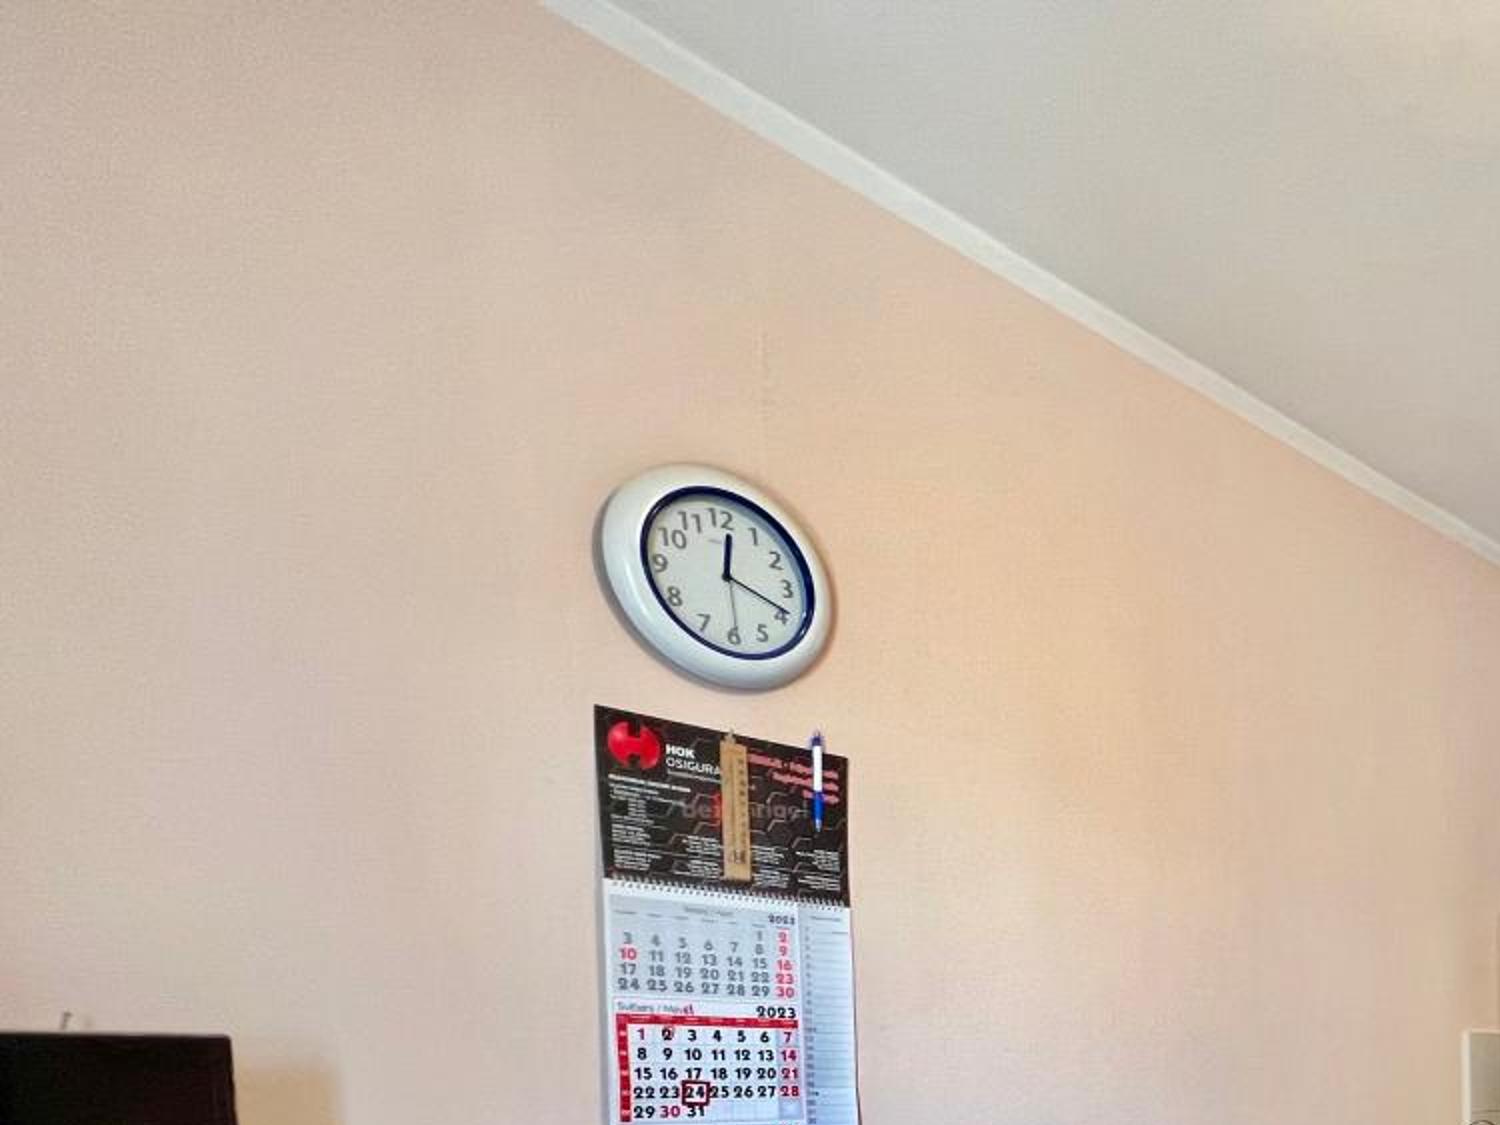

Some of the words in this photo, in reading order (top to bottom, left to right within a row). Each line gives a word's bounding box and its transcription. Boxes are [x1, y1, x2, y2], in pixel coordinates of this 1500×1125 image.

[678, 511, 703, 534] 11
[708, 507, 734, 531] 12
[658, 527, 687, 550] 10
[748, 527, 759, 546] 1
[652, 553, 668, 573] 9
[768, 551, 784, 571] 2
[666, 586, 683, 607] 8
[781, 579, 794, 599] 3
[696, 614, 712, 632] 7
[774, 611, 790, 626] 4
[727, 628, 741, 645] 6
[756, 624, 769, 643] 5
[666, 744, 695, 758] HOK
[623, 932, 632, 944] 3
[651, 934, 660, 946] 4
[678, 937, 687, 948] 5
[704, 939, 714, 950] 6
[730, 942, 738, 952] 7
[755, 944, 764, 955] 8
[779, 946, 787, 956] 9
[756, 931, 762, 941] 1
[619, 948, 637, 960] 10
[649, 950, 664, 962] 11
[675, 952, 691, 964] 12
[702, 954, 717, 966] 13
[727, 958, 743, 966] 14
[753, 958, 768, 969] 15
[777, 960, 793, 970] 16
[620, 963, 636, 975] 17
[649, 965, 665, 977] 18
[675, 967, 692, 978] 19
[700, 968, 719, 980] 20
[728, 970, 744, 981] 21
[751, 972, 769, 983] 22
[775, 974, 793, 984] 23
[617, 977, 640, 990] 24
[646, 979, 667, 992] 25
[674, 981, 694, 993] 26
[701, 983, 719, 994] 27
[726, 984, 745, 996] 28
[751, 986, 770, 997] 29
[775, 987, 794, 998] 30
[756, 1006, 796, 1019] 2023
[637, 1028, 645, 1041] 1
[661, 1028, 673, 1041] 2
[687, 1029, 697, 1041] 3
[713, 1030, 722, 1042] 4
[737, 1030, 746, 1042] 5
[760, 1032, 769, 1043] 6
[784, 1032, 791, 1043] 7
[637, 1048, 647, 1060] 8
[663, 1048, 673, 1060] 9
[685, 1049, 702, 1060] 10
[711, 1049, 726, 1060] 11
[734, 1050, 751, 1061] 12
[758, 1050, 774, 1061] 13
[781, 1050, 797, 1061] 14
[634, 1068, 652, 1080] 15
[660, 1068, 678, 1080] 16
[685, 1068, 703, 1079] 17
[710, 1068, 728, 1079] 18
[735, 1068, 752, 1079] 19
[757, 1068, 776, 1079] 20
[781, 1068, 798, 1079] 21
[633, 1087, 655, 1098] 22
[659, 1087, 680, 1098] 23
[686, 1086, 705, 1098] 24
[710, 1086, 729, 1098] 25
[733, 1086, 753, 1098] 26
[757, 1086, 776, 1098] 27
[780, 1086, 799, 1097] 28
[633, 1107, 655, 1118] 29
[660, 1106, 680, 1118] 30
[687, 1105, 705, 1118] 31
